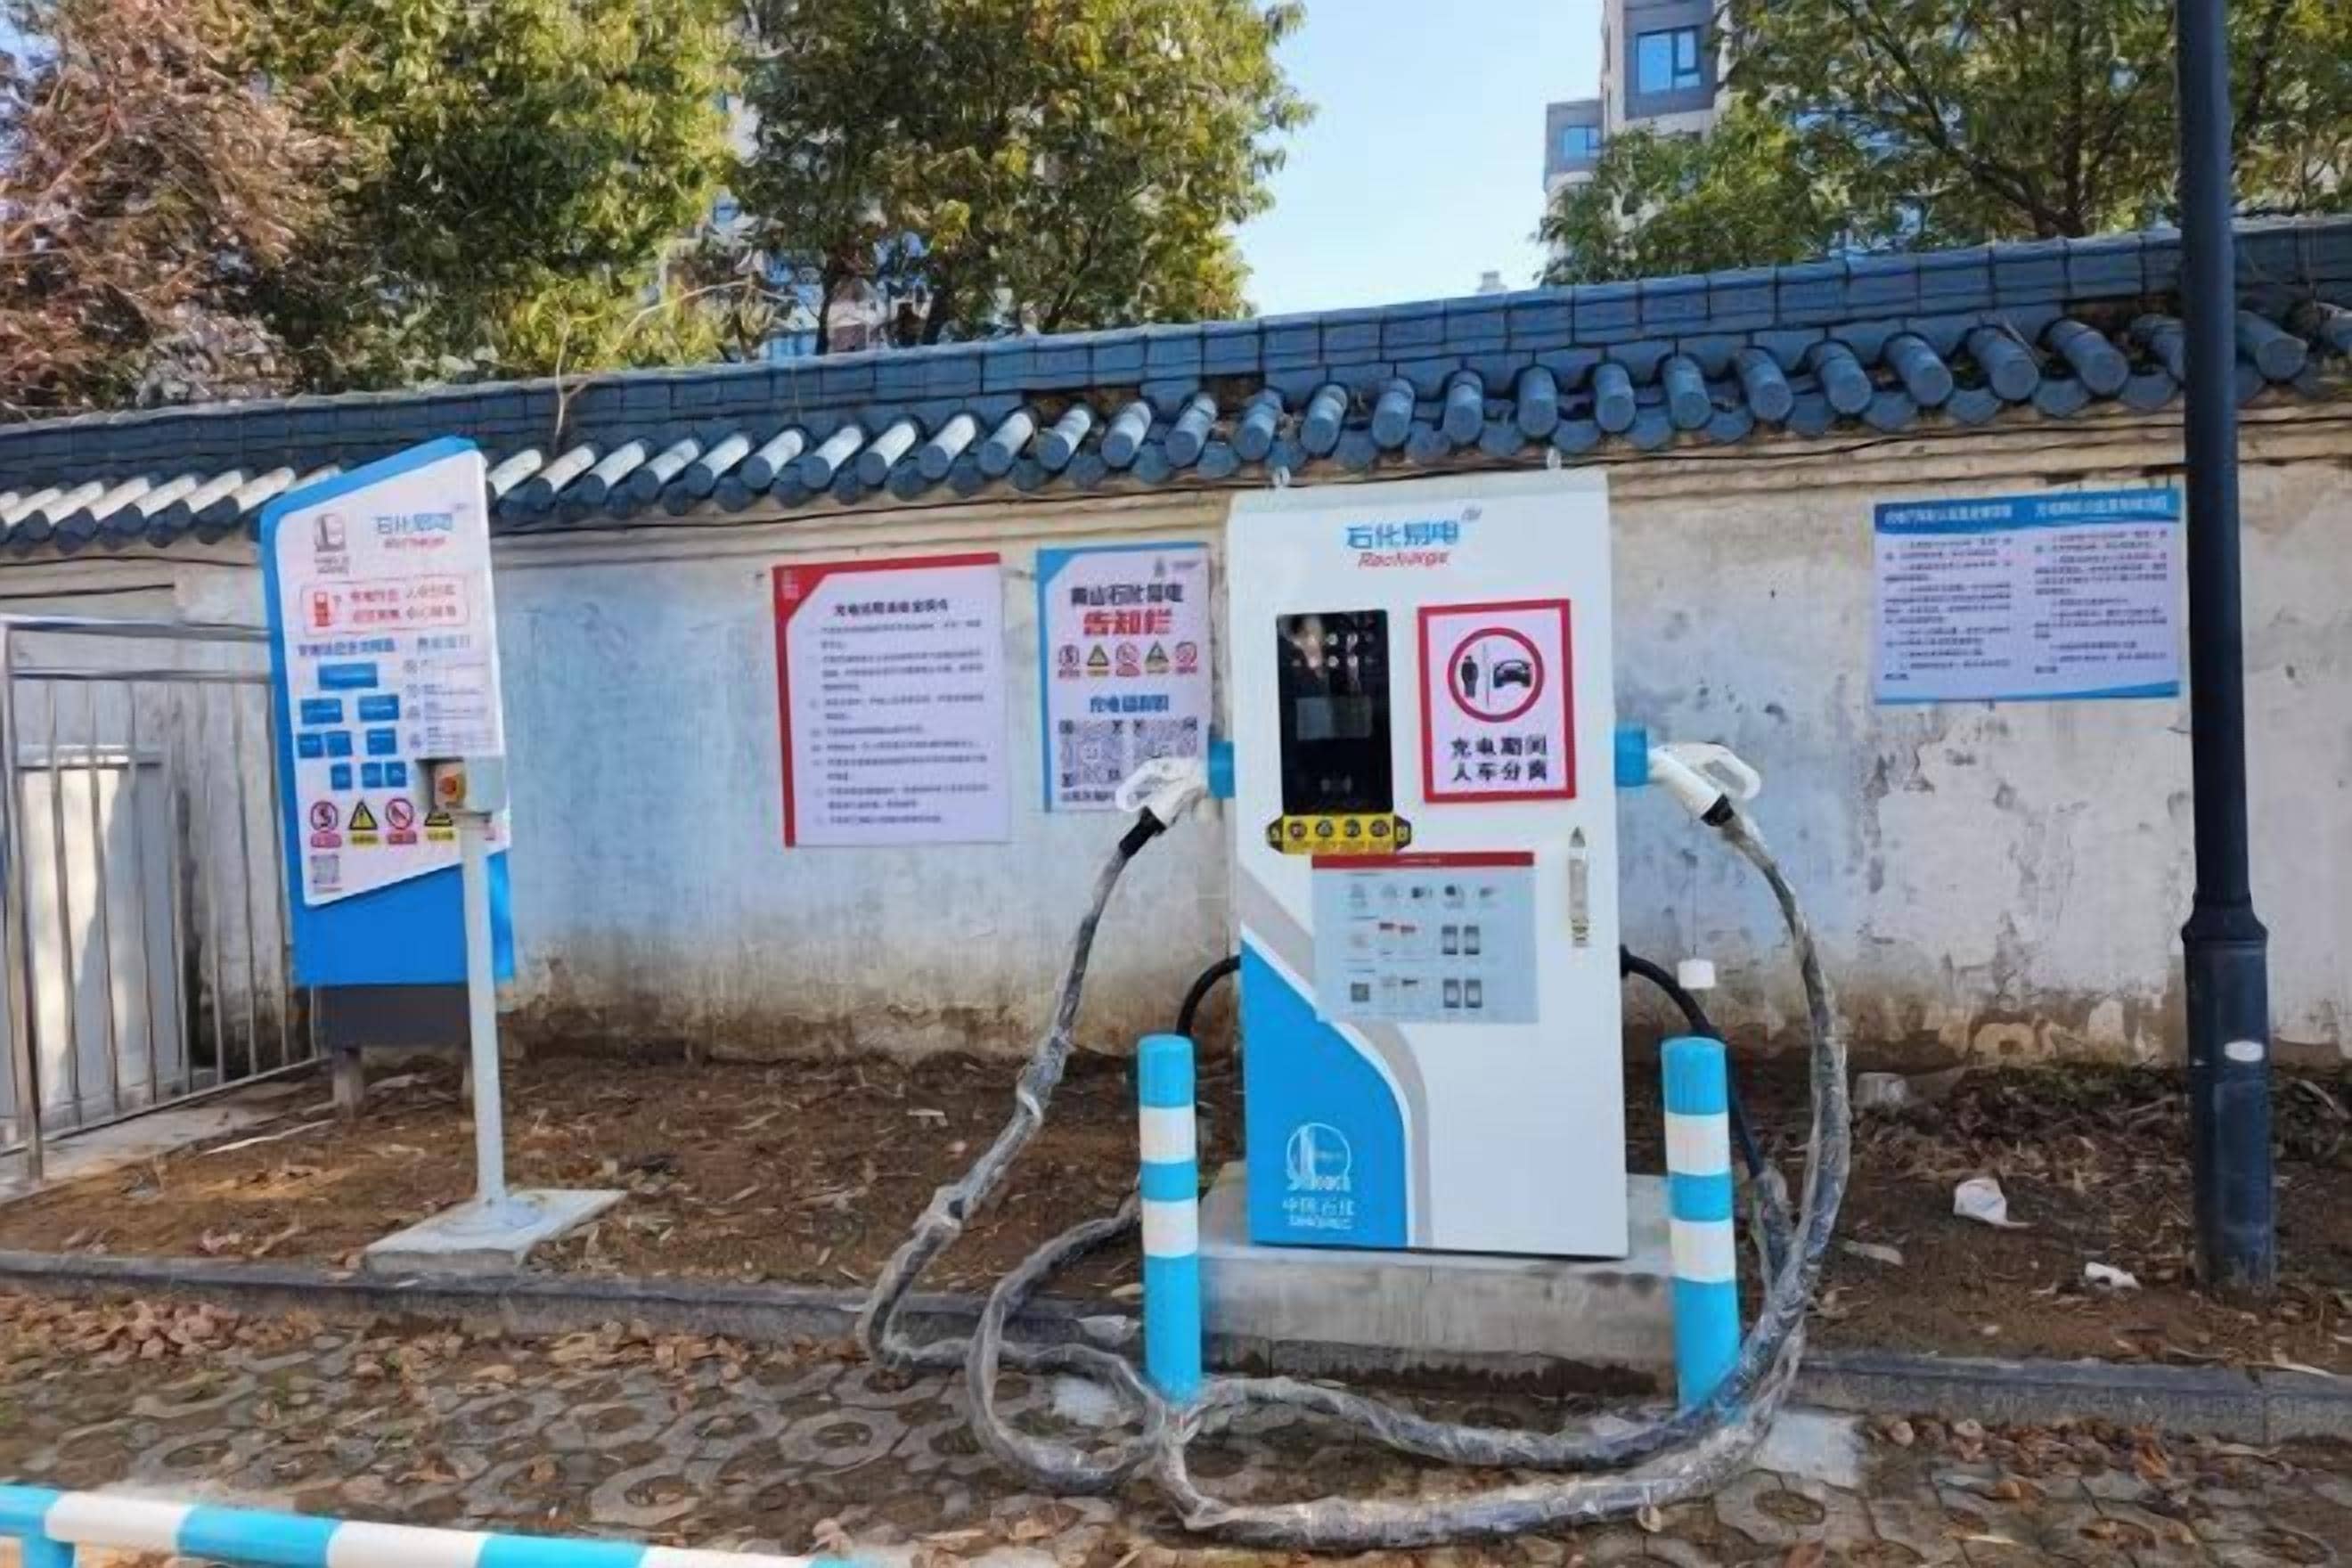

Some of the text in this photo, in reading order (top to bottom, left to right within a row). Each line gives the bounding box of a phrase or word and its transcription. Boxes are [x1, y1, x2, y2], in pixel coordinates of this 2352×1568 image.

[1450, 735, 1548, 758] 充电期间
[1453, 759, 1548, 781] 人车分离
